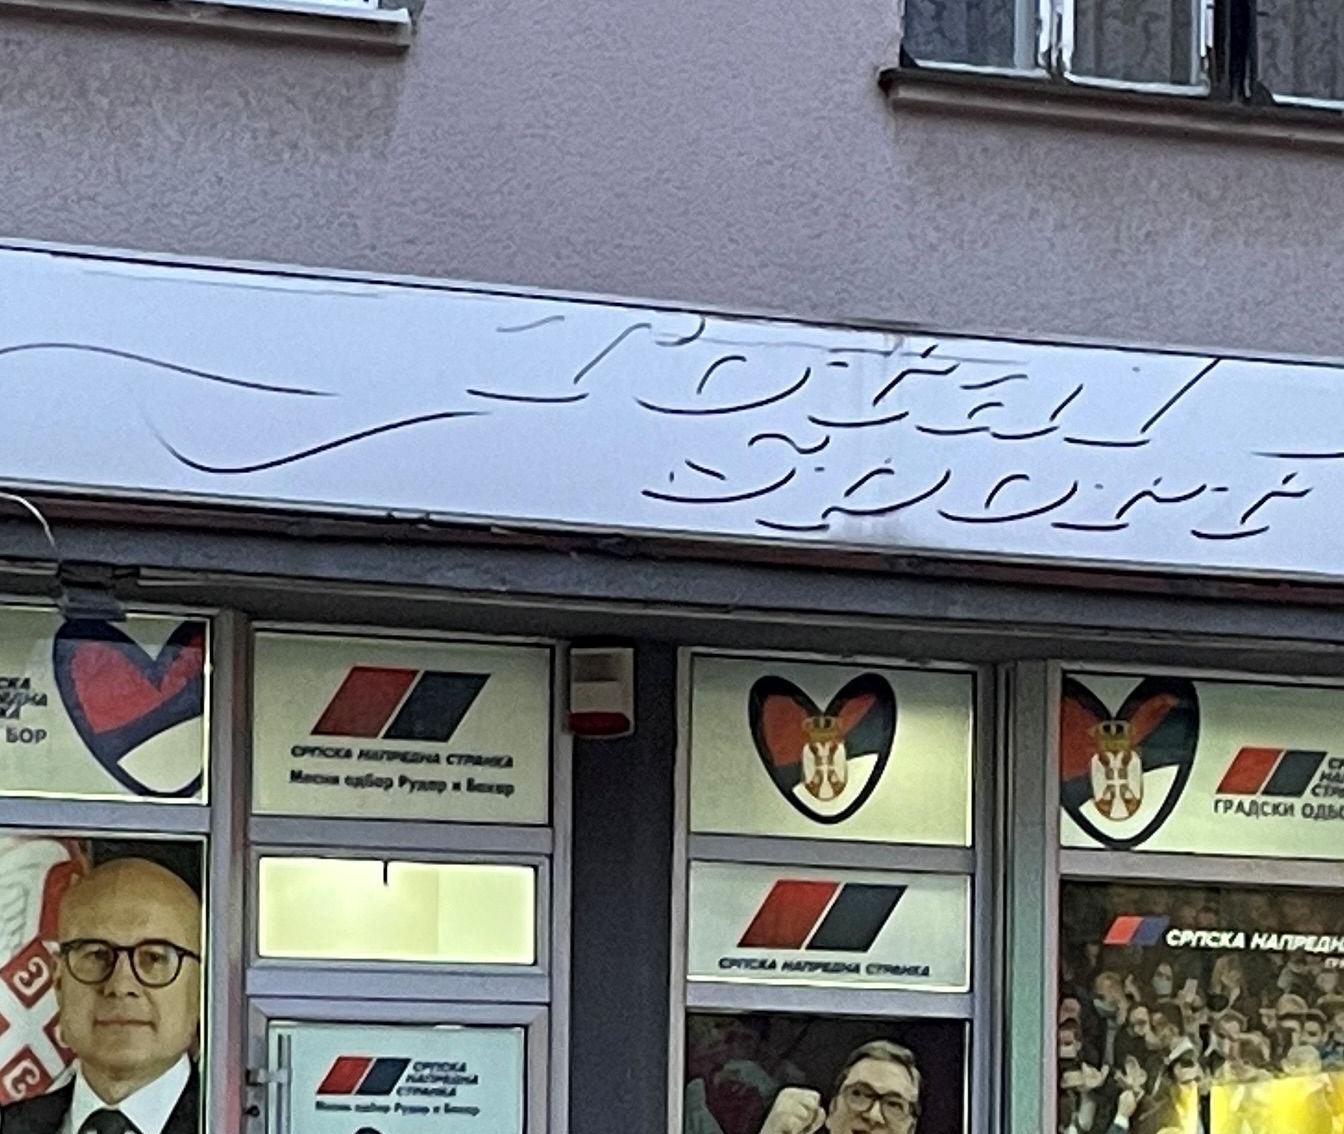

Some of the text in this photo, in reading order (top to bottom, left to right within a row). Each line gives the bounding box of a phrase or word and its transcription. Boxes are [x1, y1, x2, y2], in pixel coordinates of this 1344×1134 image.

[5, 726, 48, 744] БОР
[290, 745, 353, 760] СРПСКА
[1213, 799, 1296, 819] ГРАДСКИ
[1166, 928, 1246, 950] СРПСКА
